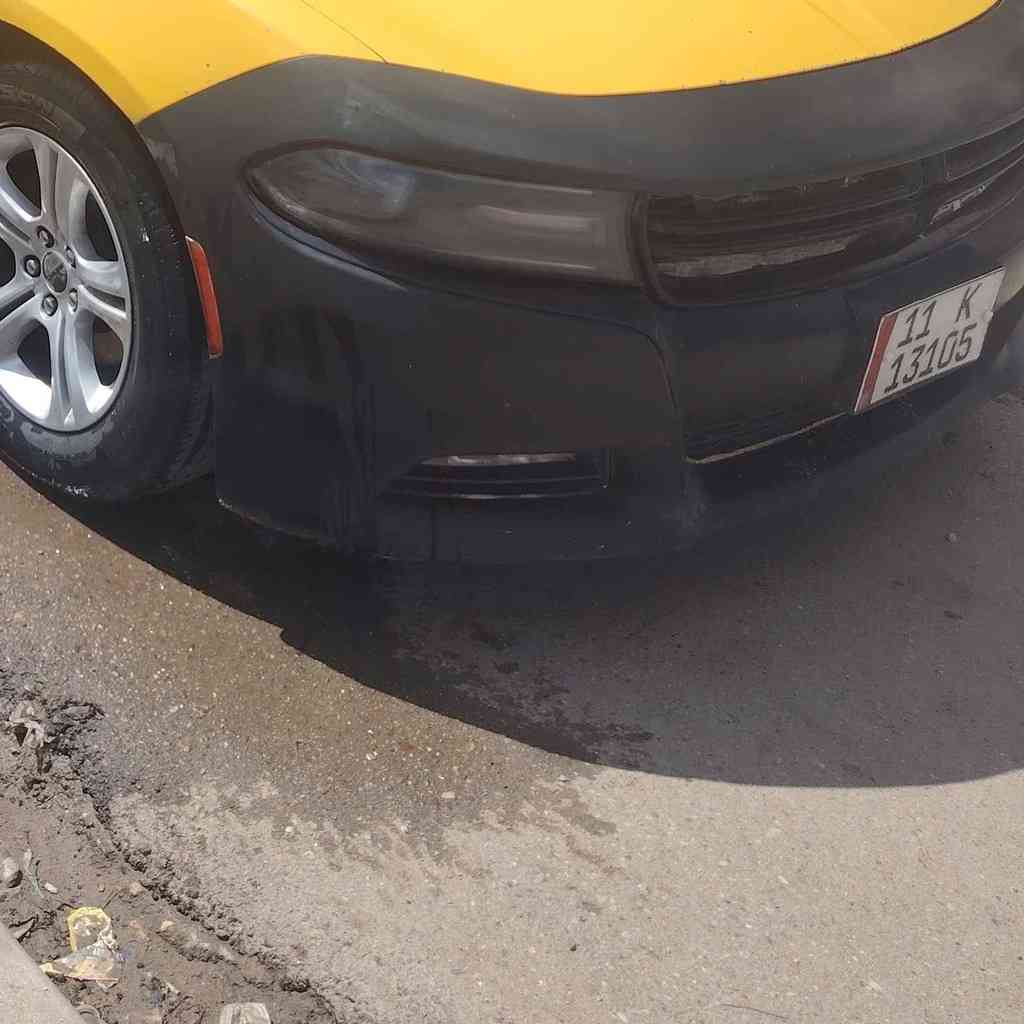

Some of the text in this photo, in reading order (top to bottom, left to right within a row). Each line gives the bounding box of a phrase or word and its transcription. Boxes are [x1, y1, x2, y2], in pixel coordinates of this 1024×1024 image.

[897, 282, 984, 349] 11 K
[883, 321, 978, 394] 13105
